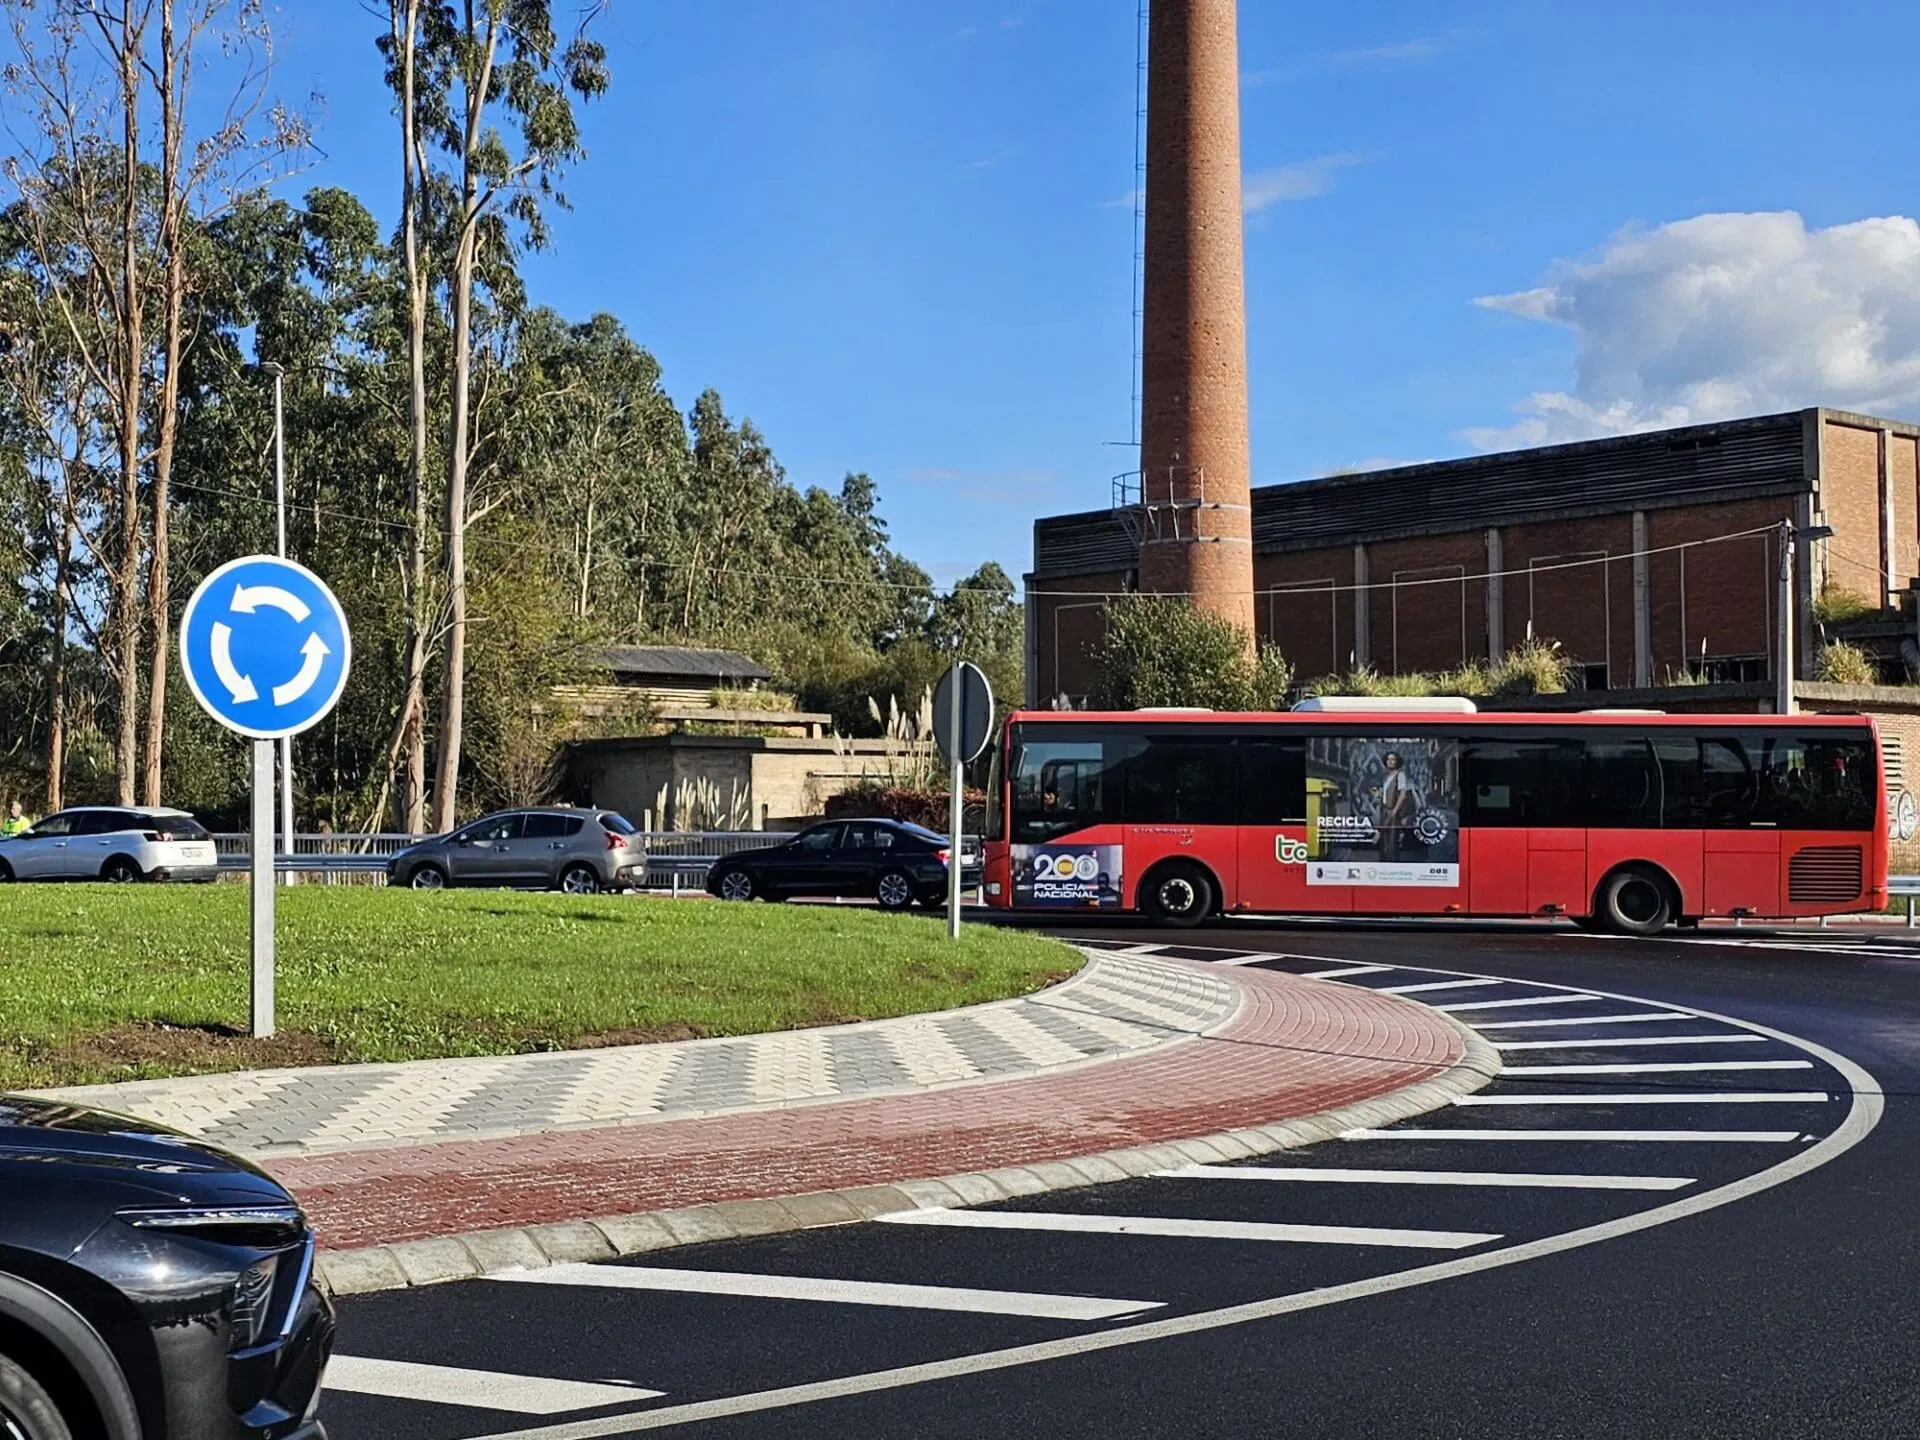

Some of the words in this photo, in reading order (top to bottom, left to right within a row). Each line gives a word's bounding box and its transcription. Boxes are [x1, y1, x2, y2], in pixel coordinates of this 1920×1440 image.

[1317, 816, 1372, 827] RECICLA
[1413, 829, 1448, 845] CIRCULAR
[1034, 854, 1099, 880] 200
[1034, 890, 1099, 898] NACIONAL
